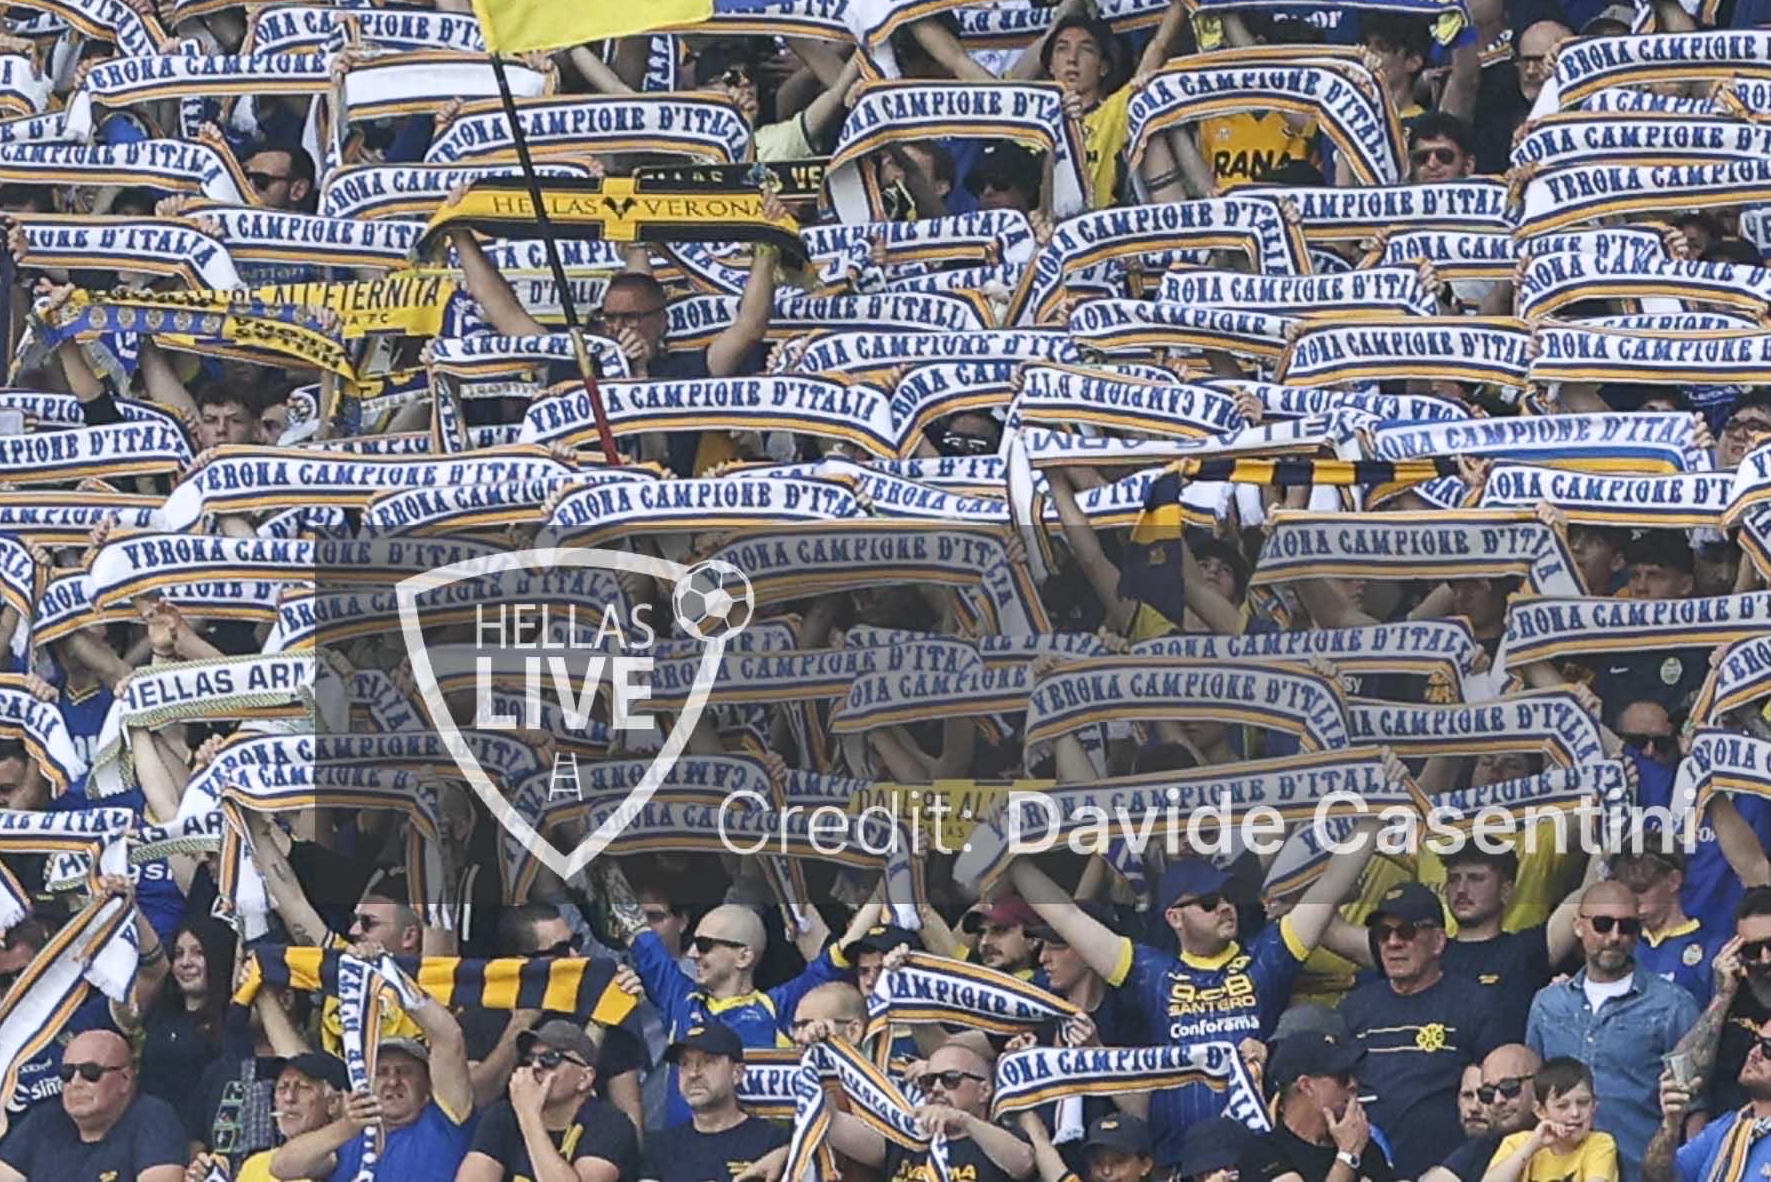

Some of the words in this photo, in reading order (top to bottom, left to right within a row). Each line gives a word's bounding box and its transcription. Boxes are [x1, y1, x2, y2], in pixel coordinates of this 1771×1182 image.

[1637, 35, 1754, 61] CAMPIONE
[882, 89, 1003, 118] CAMPIONE
[1582, 124, 1721, 149] CAMPIONE
[1547, 166, 1641, 203] VERONA
[1293, 187, 1415, 218] CAMPIONE
[237, 215, 352, 245] CAMPIONE
[1083, 202, 1213, 237] CAMPIONE
[100, 226, 220, 269] D'ITALIA
[1233, 271, 1342, 300] CAMPIONE
[1346, 328, 1455, 357] CAMPIONE
[1618, 337, 1755, 362] CAMPIONE
[630, 381, 762, 407] CAMPIONE
[772, 381, 878, 421] D'ITALIA
[194, 461, 288, 494] VERONA
[298, 460, 437, 486] CAMPIONE
[1552, 478, 1683, 506] CAMPIONE
[371, 495, 450, 532] VERONA
[129, 539, 222, 570] VERONA
[797, 536, 929, 564] CAMPIONE
[1338, 524, 1470, 555] CAMPIONE
[1604, 599, 1727, 630] CAMPIONE
[1033, 672, 1121, 716] VERONA
[1130, 667, 1256, 695] CAMPIONE
[1380, 702, 1506, 733] CAMPIONE
[1169, 995, 1257, 1017] SANTERO
[1170, 1015, 1261, 1039] Conforama
